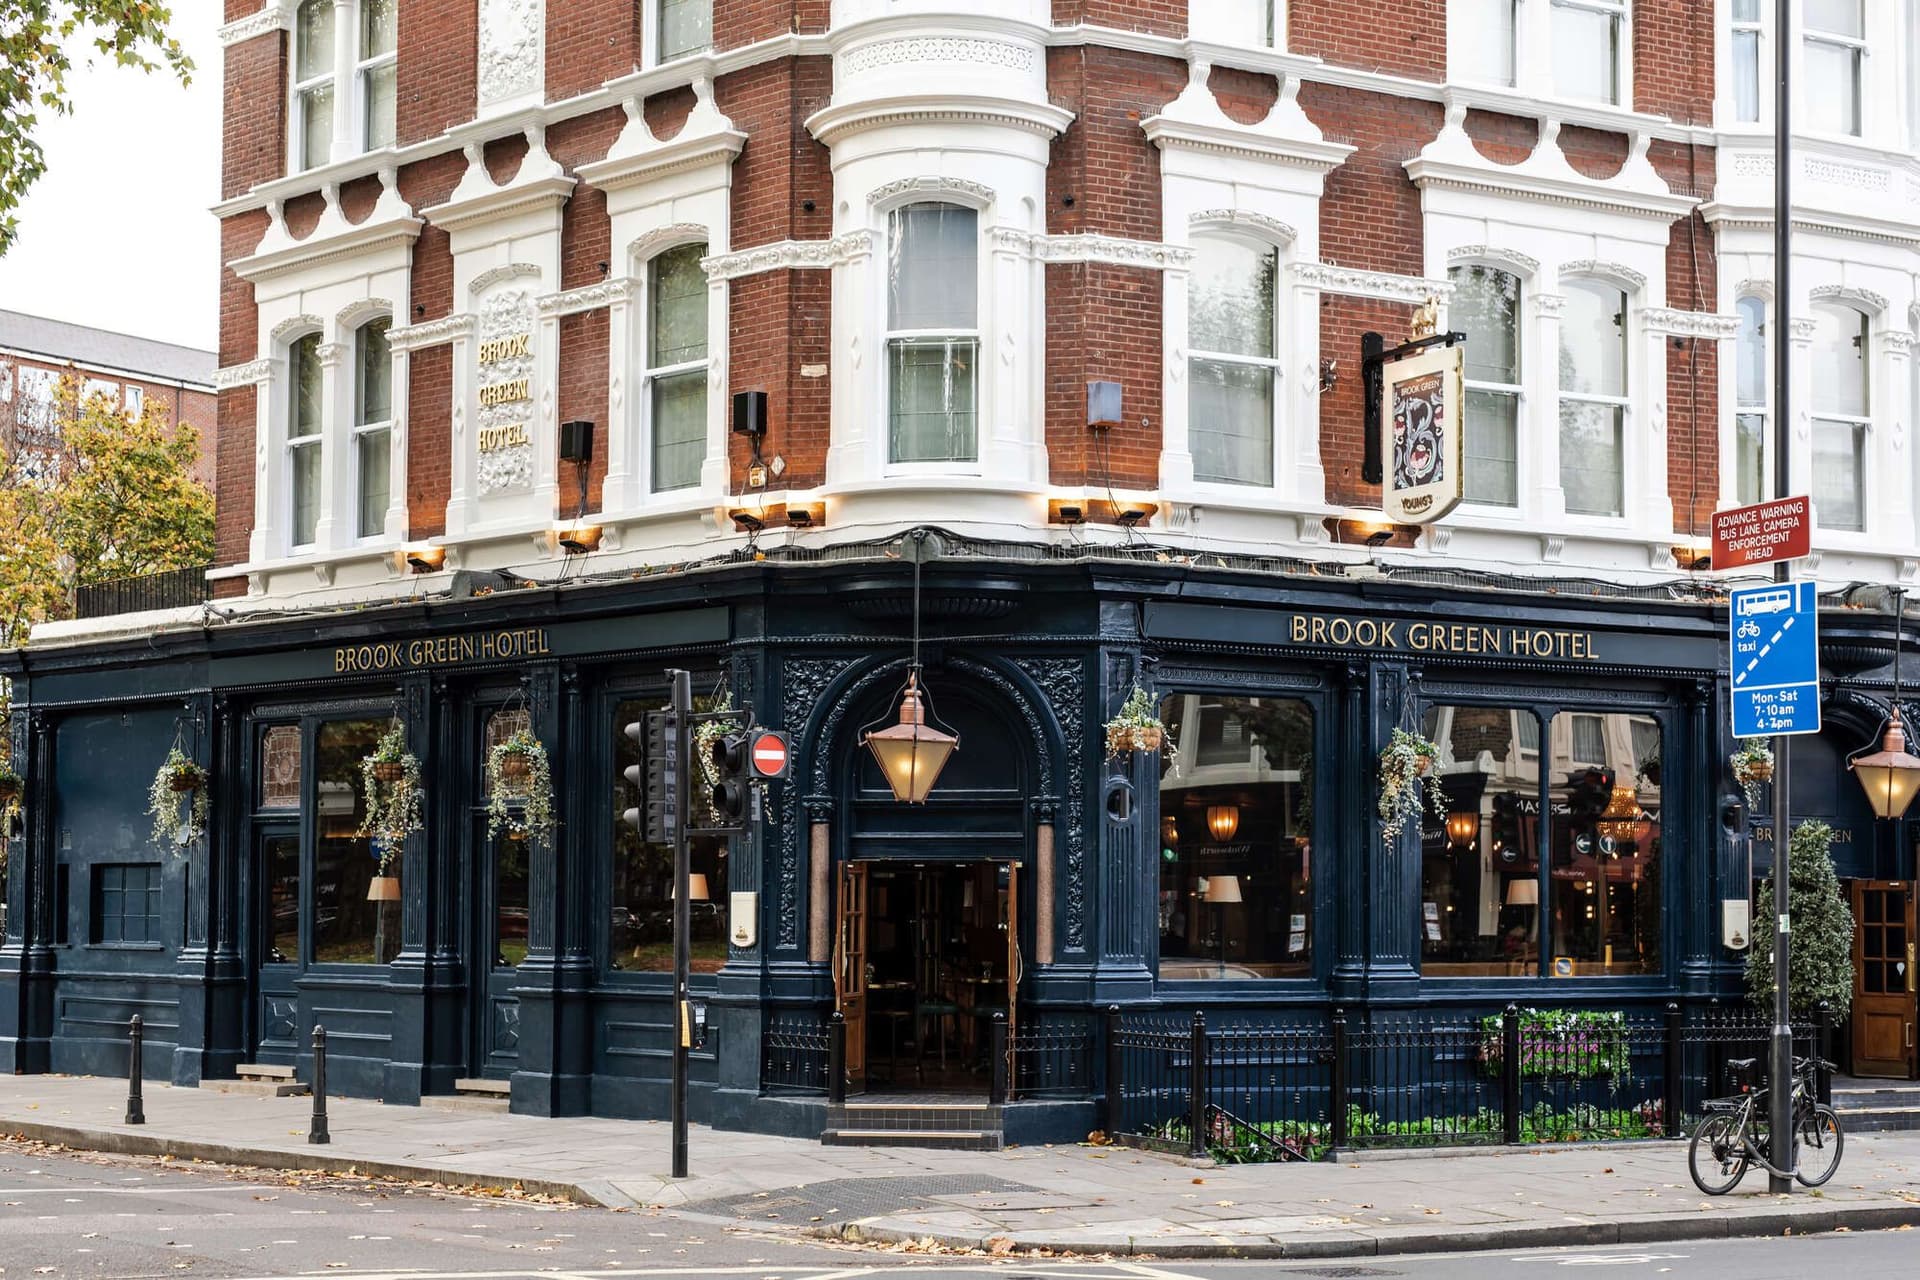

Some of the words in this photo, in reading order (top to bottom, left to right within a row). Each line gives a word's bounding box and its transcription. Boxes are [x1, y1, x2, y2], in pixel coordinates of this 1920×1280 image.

[479, 334, 529, 363] BROOK
[479, 379, 529, 407] GREEN
[1401, 384, 1421, 396] BROOK
[1421, 379, 1440, 391] GREEN
[479, 424, 528, 451] HOTEL
[1717, 510, 1757, 528] ADVANCE
[1760, 502, 1803, 520] WARNING
[1720, 528, 1737, 541] BUS
[1740, 523, 1760, 536] LANE
[1763, 516, 1800, 532] CAMERA
[1728, 531, 1790, 552] ENFORCEMENT
[1745, 546, 1774, 561] AHEAD
[335, 643, 401, 672] BROOK
[409, 635, 474, 665] GREEN
[481, 629, 549, 658] HOTEL
[1291, 615, 1397, 648] BROOK
[1407, 622, 1501, 654] GREEN
[1511, 629, 1600, 660] HOTEL
[1737, 640, 1756, 653] taxi
